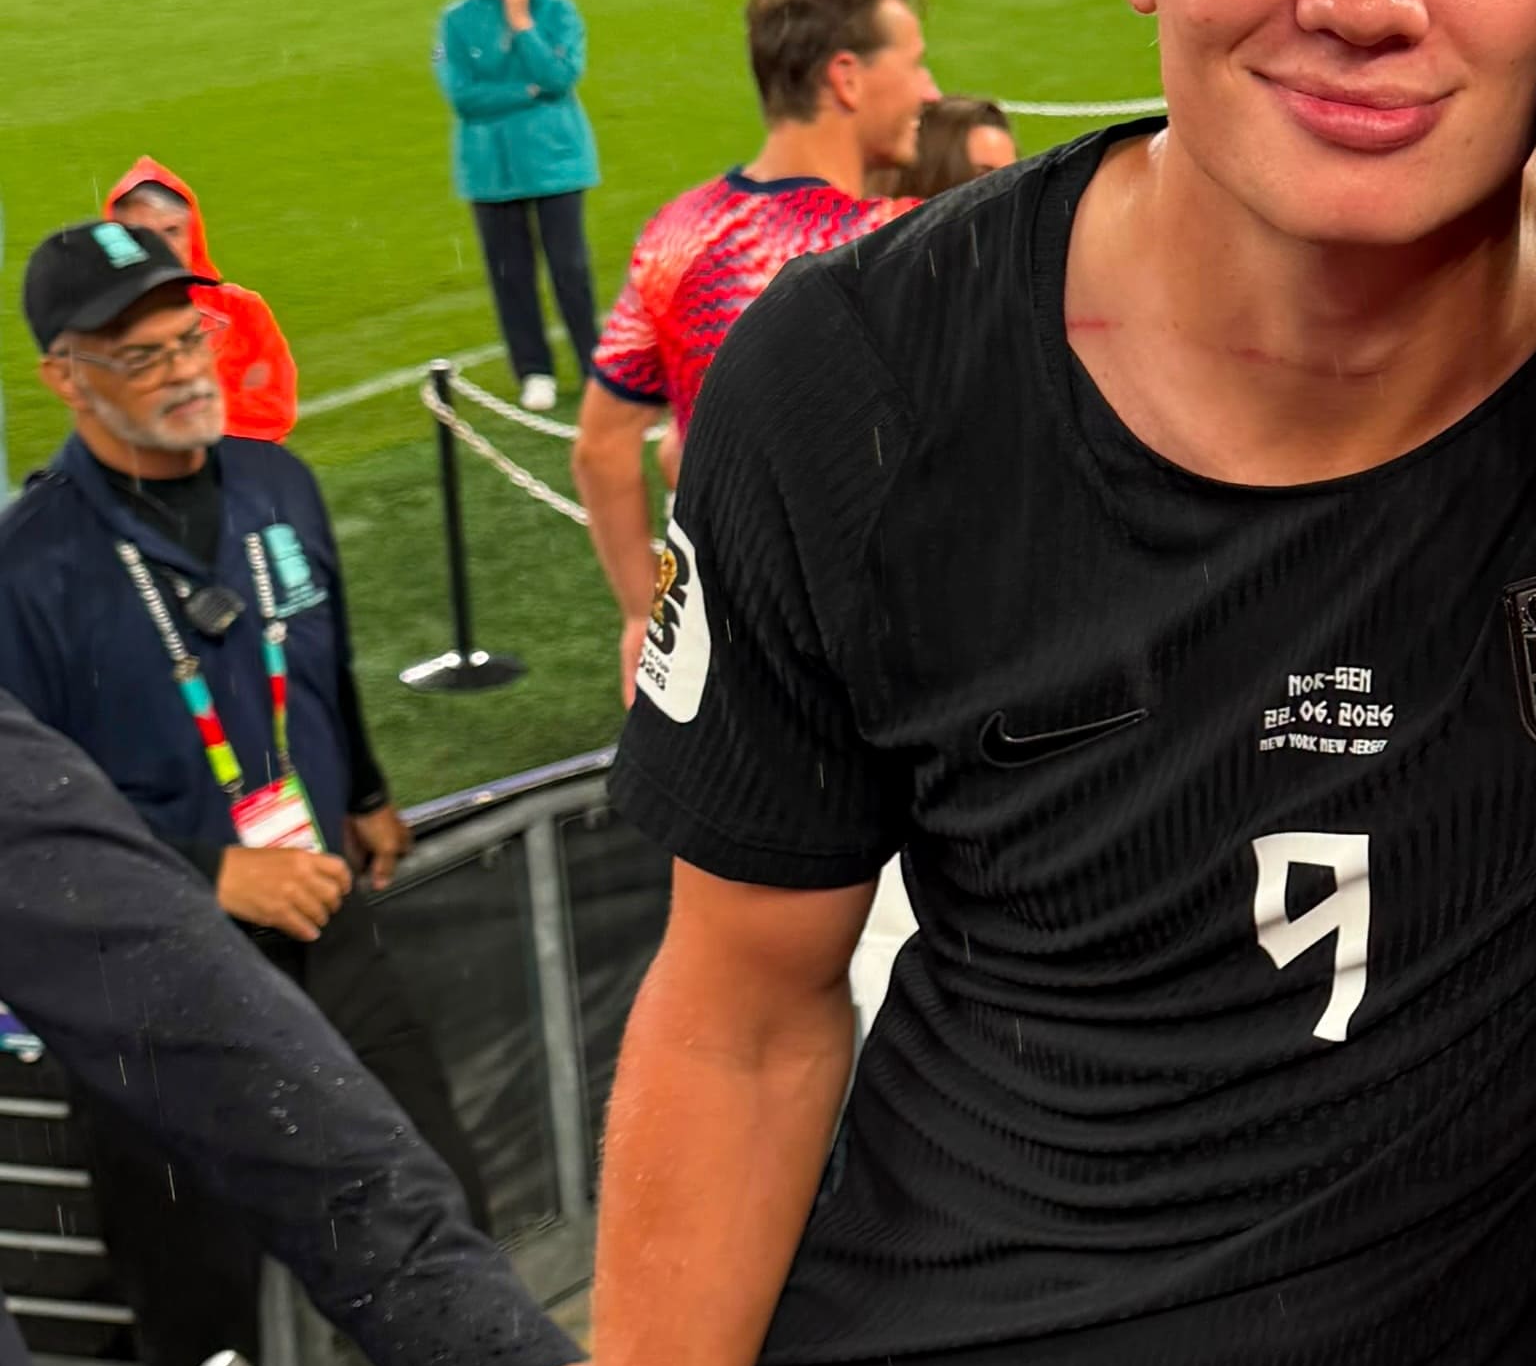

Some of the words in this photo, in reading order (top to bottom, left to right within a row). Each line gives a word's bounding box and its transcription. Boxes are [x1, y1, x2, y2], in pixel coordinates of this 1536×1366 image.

[1288, 666, 1372, 697] NOR-SEN
[1259, 734, 1286, 751] NEW
[1288, 733, 1318, 752] YORK
[1319, 737, 1347, 754] NEW
[1252, 832, 1370, 1042] 9
